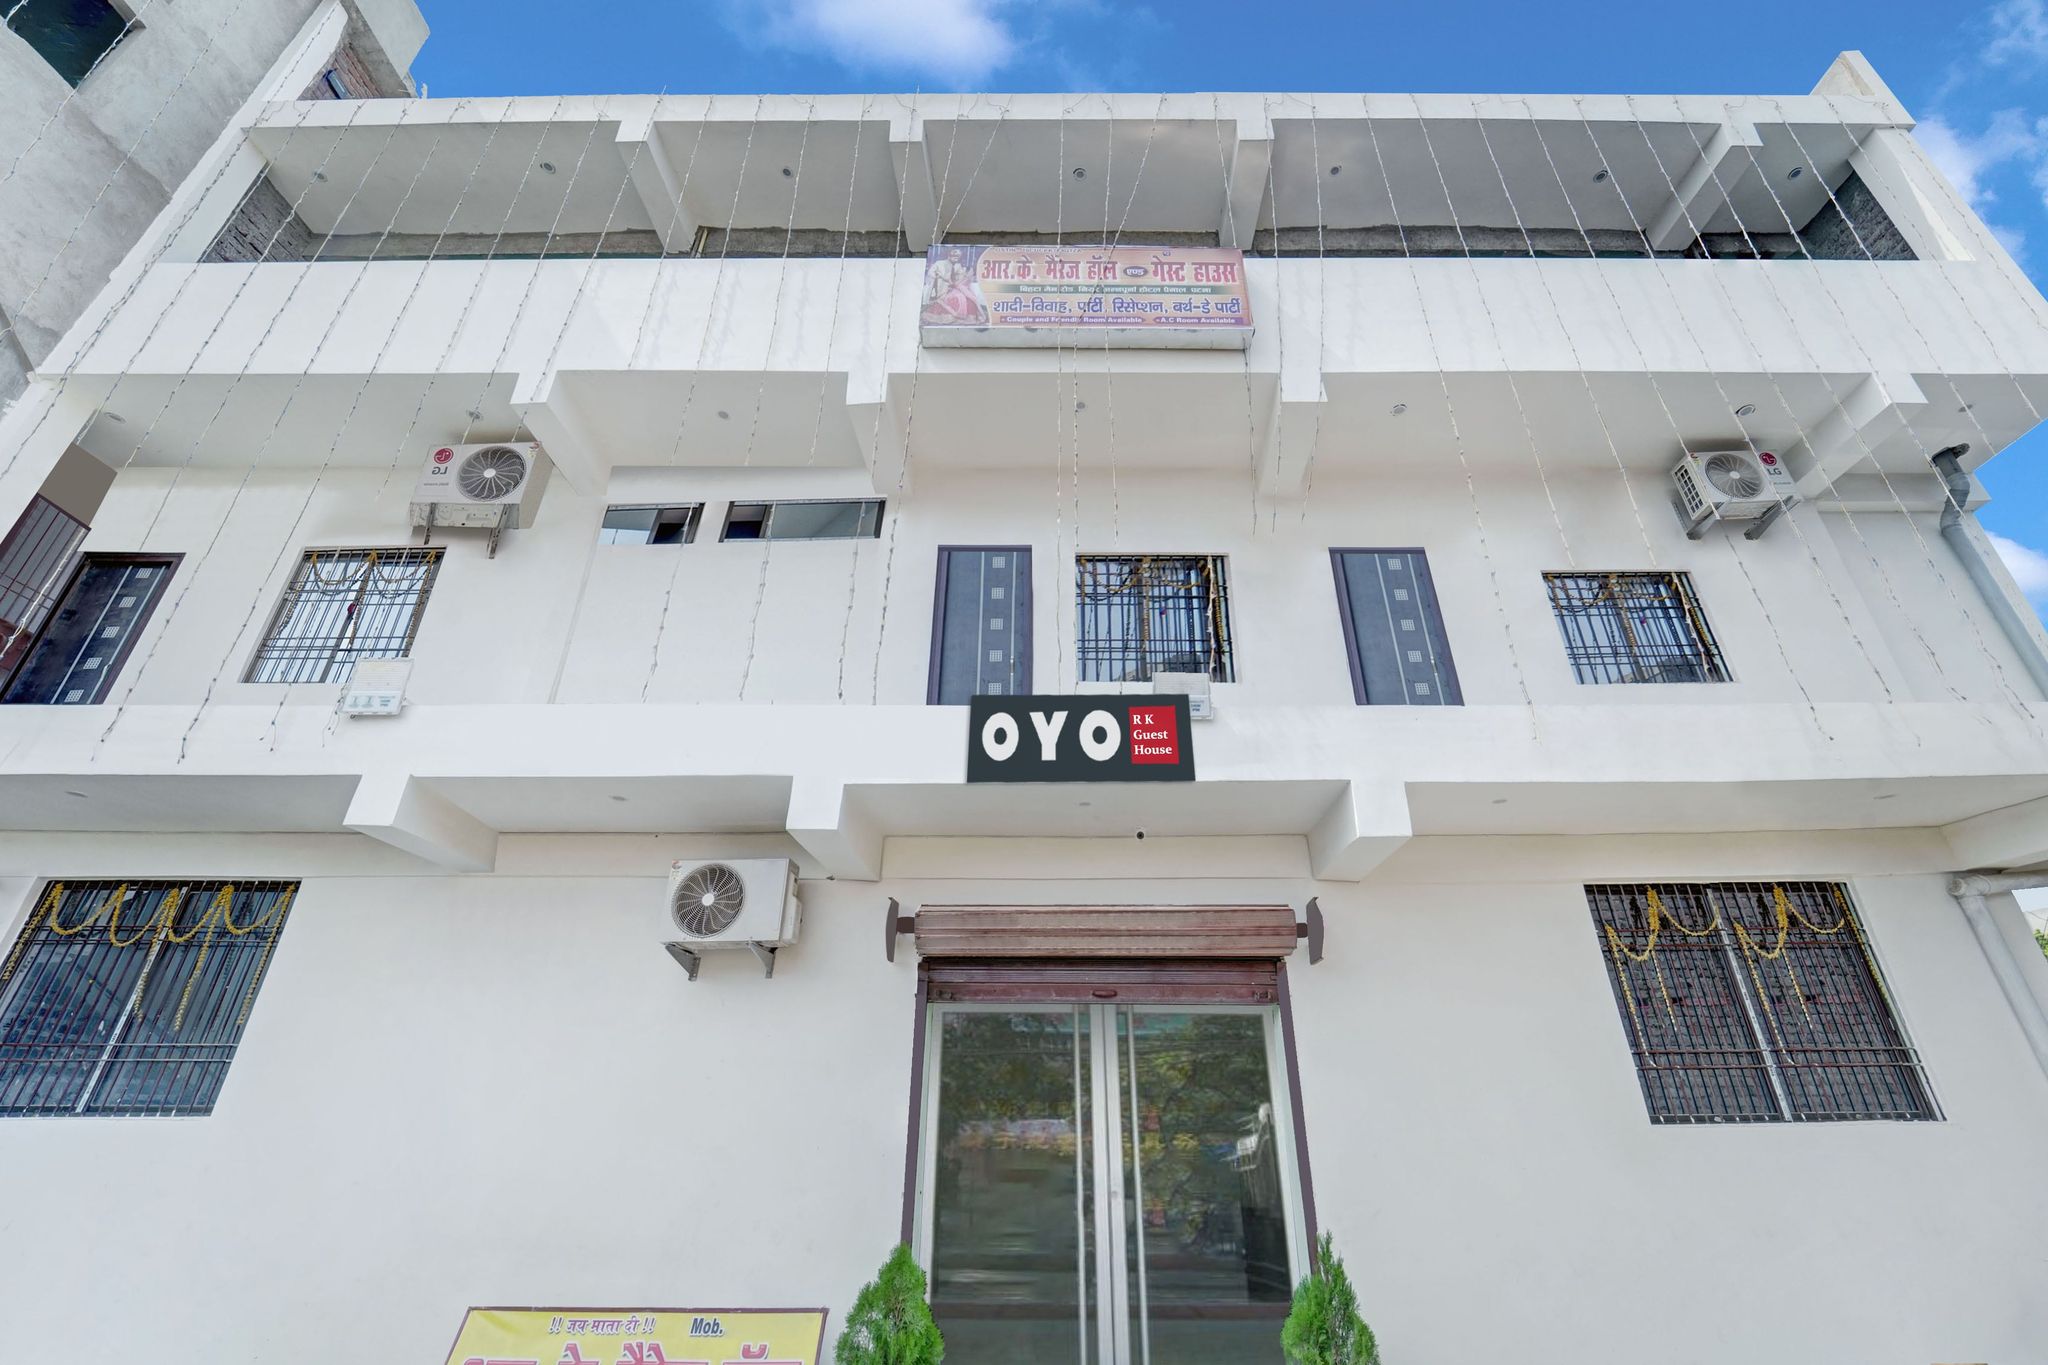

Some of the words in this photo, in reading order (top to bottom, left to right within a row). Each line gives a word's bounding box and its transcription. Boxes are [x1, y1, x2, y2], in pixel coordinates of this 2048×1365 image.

[1151, 255, 1185, 282] गेस्ट
[1192, 262, 1236, 283] हाउस
[1214, 298, 1240, 314] पार्टी
[1766, 467, 1782, 476] LG
[981, 709, 1122, 762] OYO
[1133, 729, 1169, 740] Guest
[1134, 744, 1173, 755] House
[567, 1319, 588, 1333] जय
[590, 1319, 623, 1334] माता
[624, 1316, 640, 1334] दी
[690, 1317, 724, 1336] Mob.
